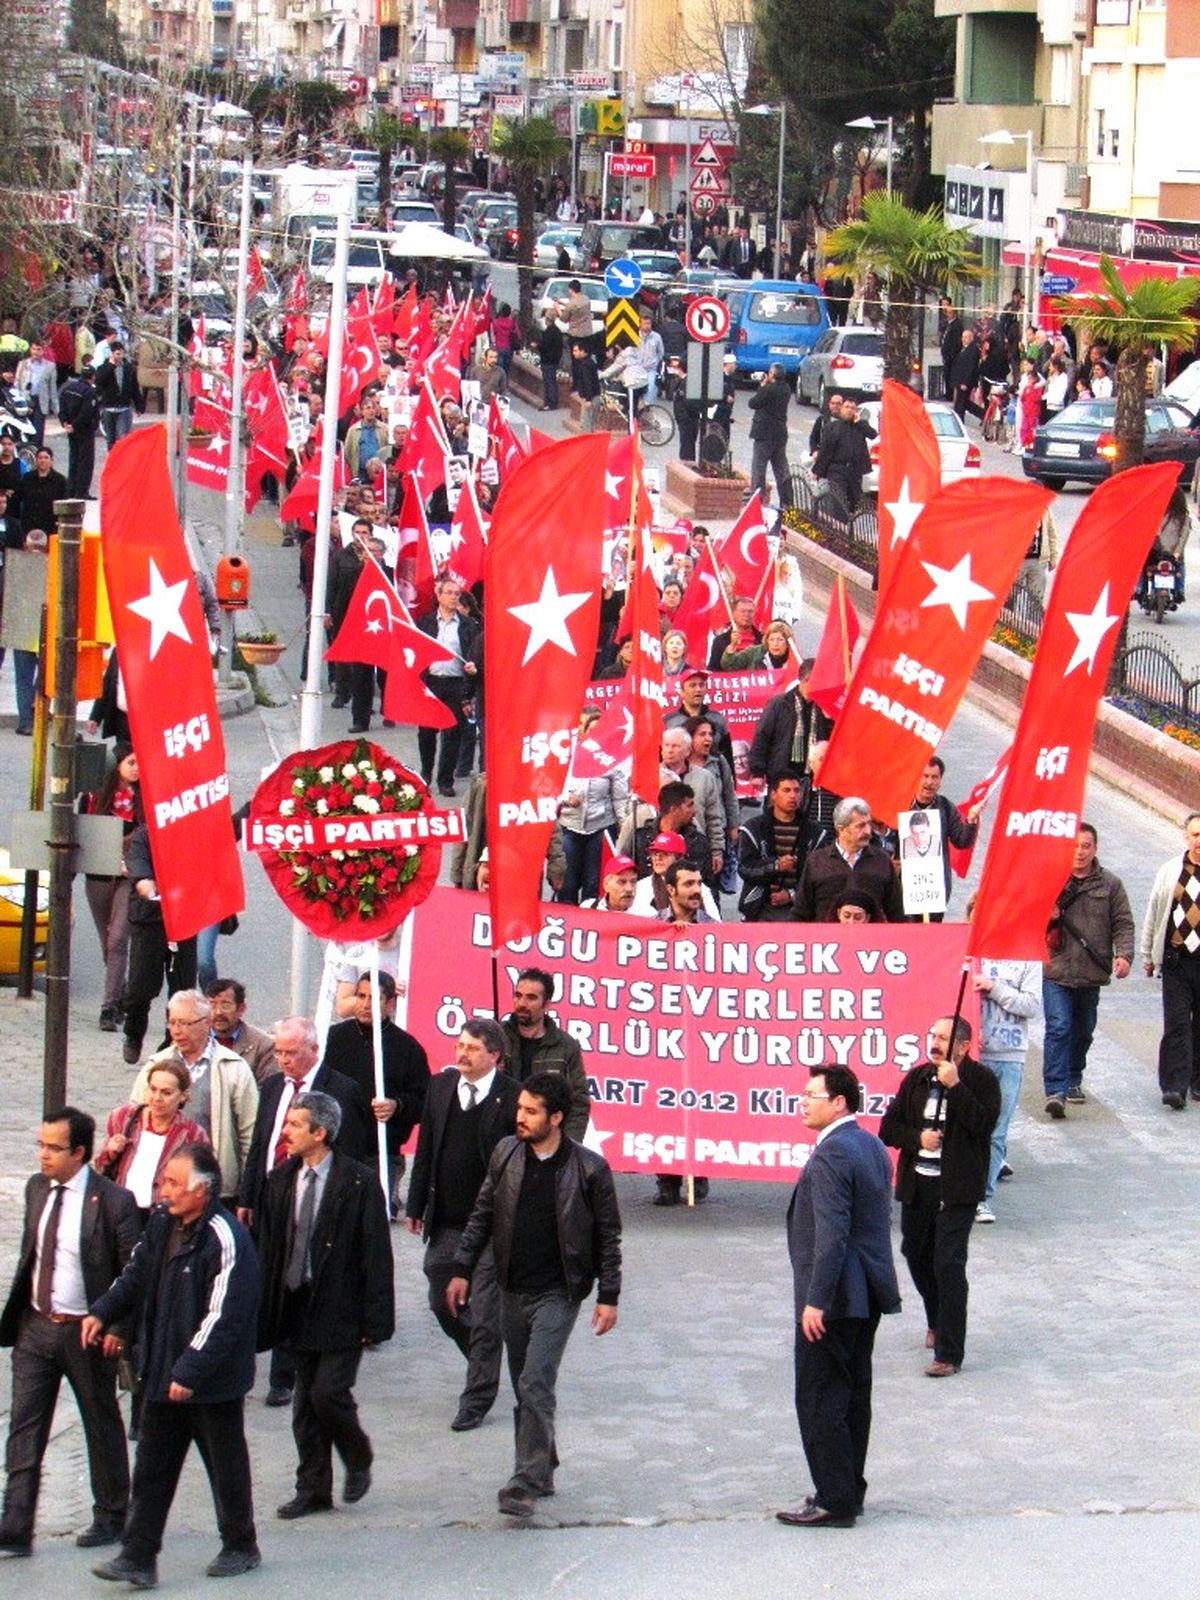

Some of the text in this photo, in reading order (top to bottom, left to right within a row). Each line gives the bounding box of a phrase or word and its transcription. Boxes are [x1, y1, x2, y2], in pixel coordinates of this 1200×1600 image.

[163, 713, 210, 759] İŞÇİ
[252, 810, 460, 849] İŞÇİ PARTİSİ
[616, 933, 841, 983] PERİNÇEK
[855, 948, 909, 975] ve
[700, 1026, 938, 1071] YÜRÜYÜŞ
[587, 1076, 648, 1106] ART
[656, 1087, 738, 1114] 2012
[622, 1131, 687, 1165] İŞÇİ
